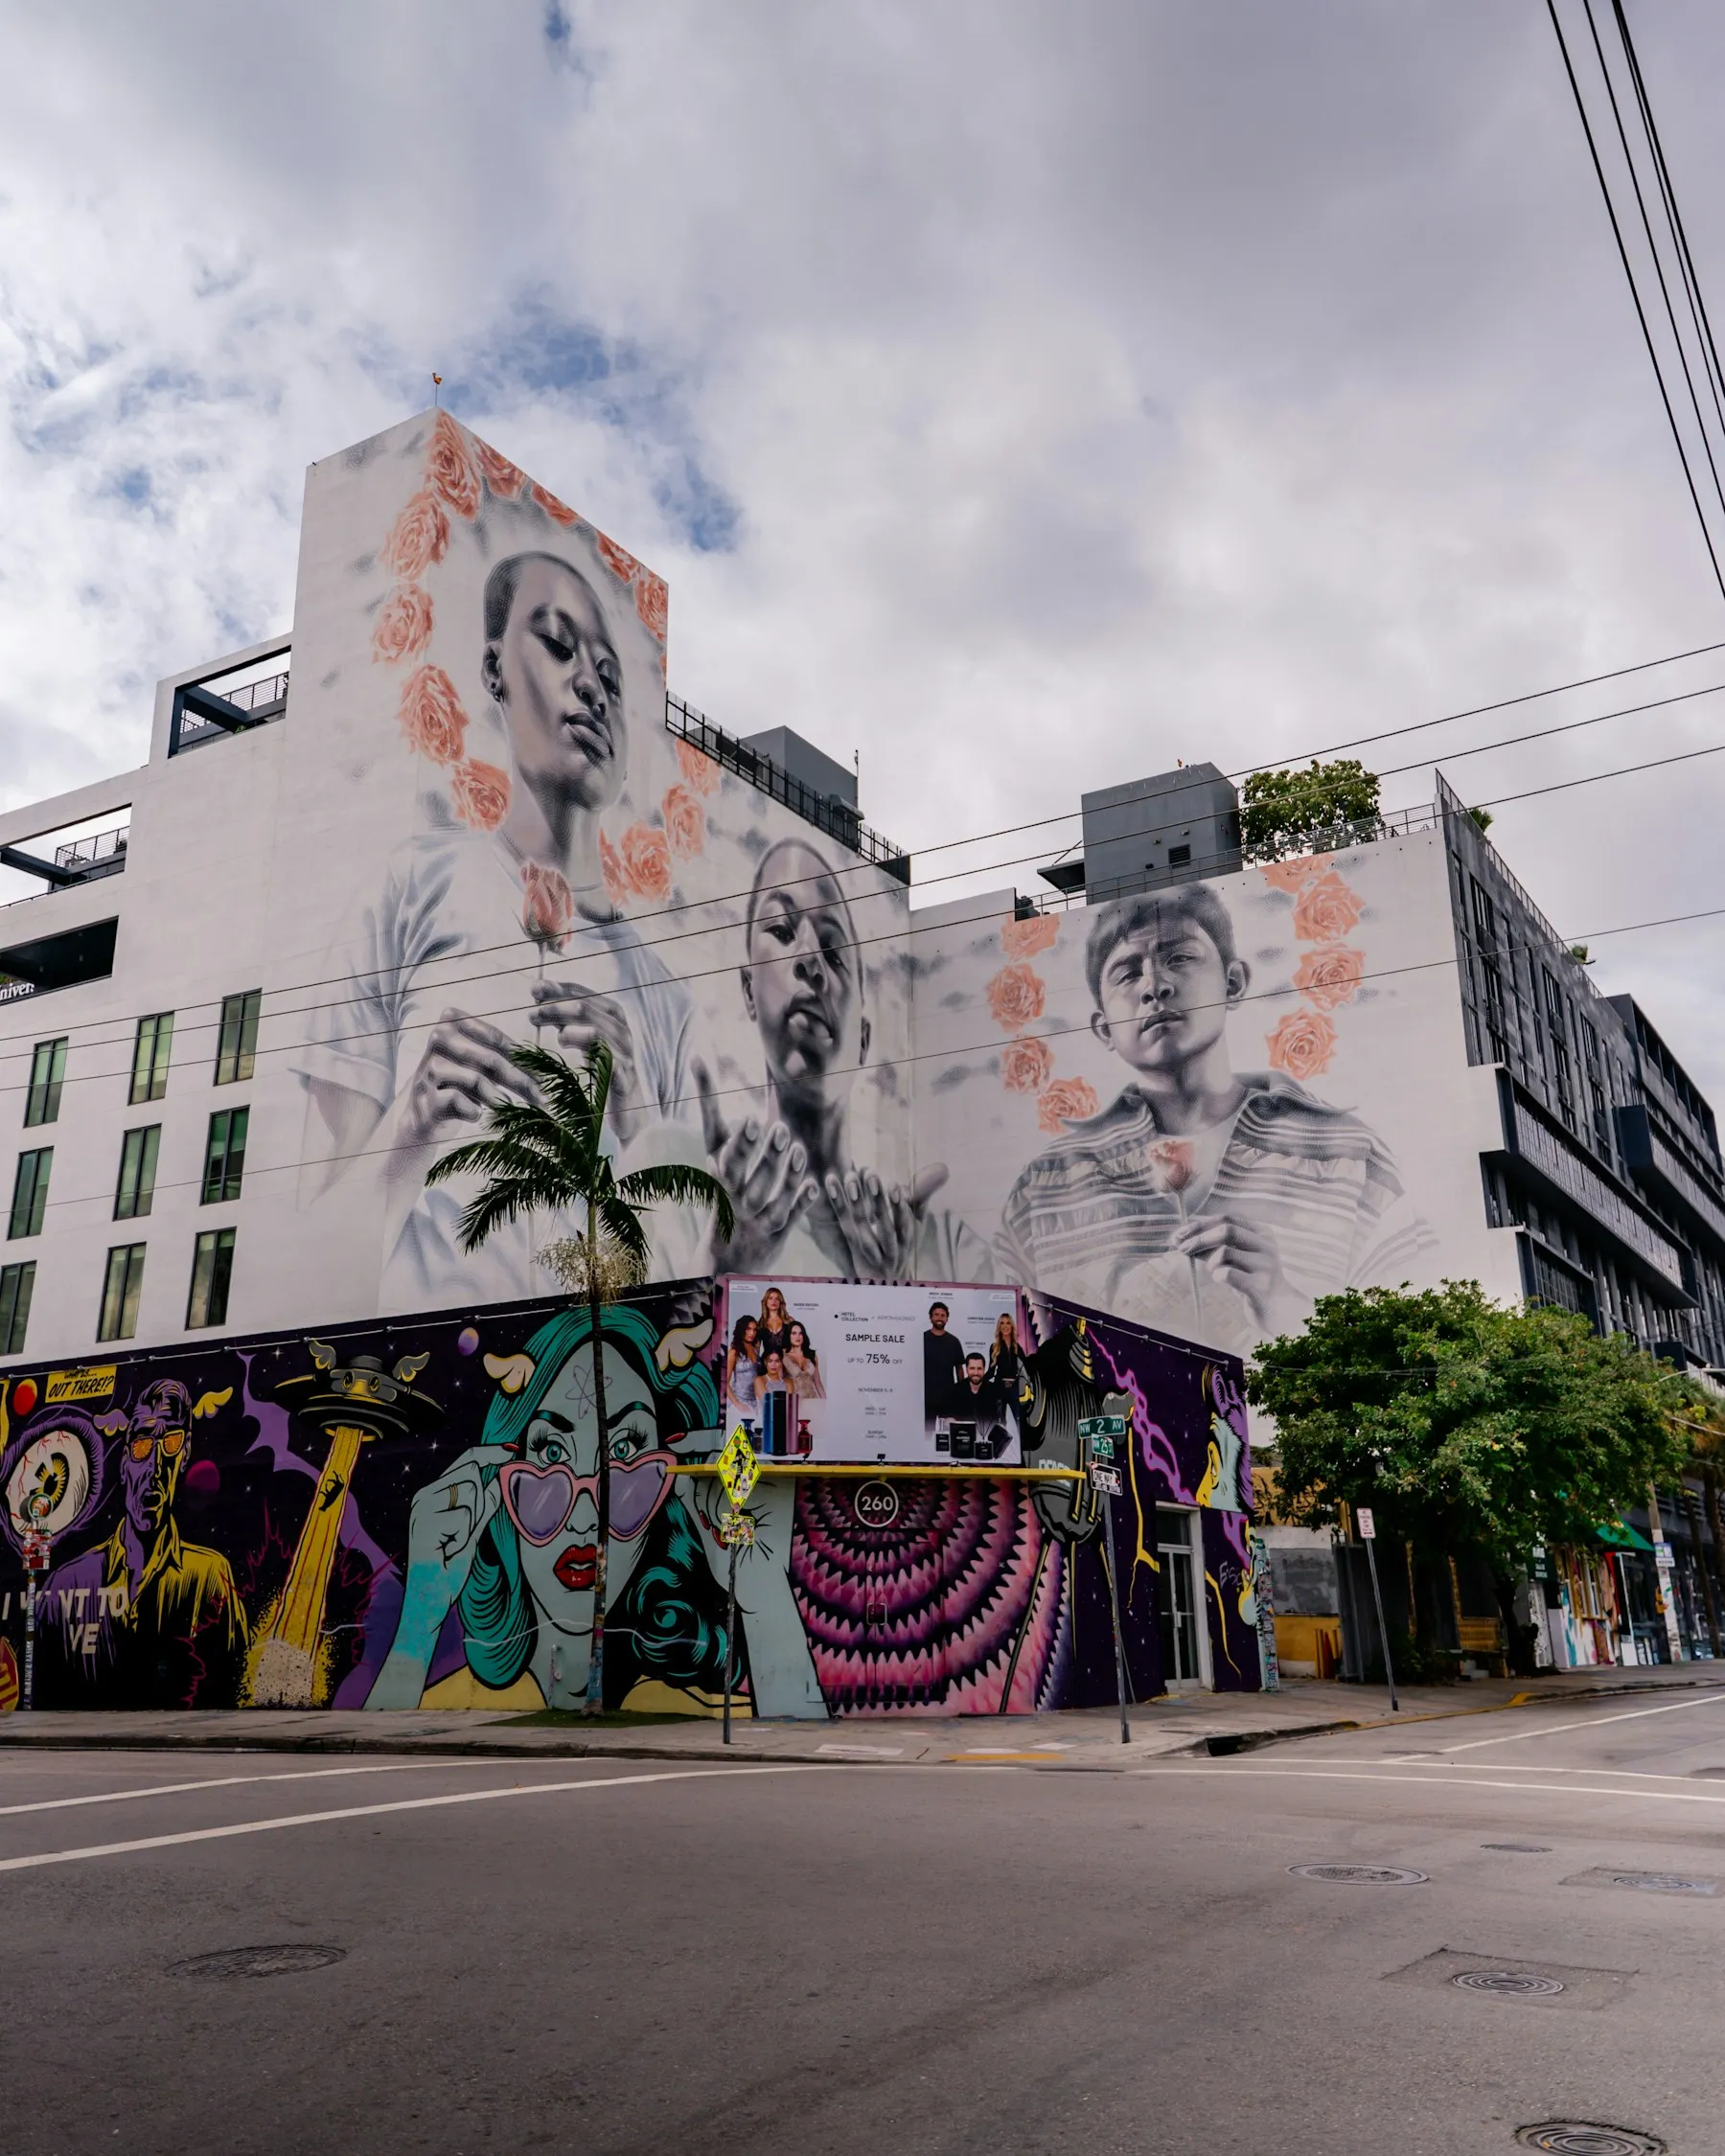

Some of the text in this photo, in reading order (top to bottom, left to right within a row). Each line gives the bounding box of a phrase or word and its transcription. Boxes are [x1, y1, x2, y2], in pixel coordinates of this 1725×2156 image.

[845, 1333, 906, 1343] SAMPLE SALE
[865, 1353, 890, 1365] 75%
[48, 1381, 72, 1398] OUT
[1080, 1419, 1122, 1434] NW 2 AV
[1093, 1470, 1103, 1482] ONE
[862, 1496, 893, 1511] 260
[2, 1592, 12, 1620] I
[97, 1586, 129, 1617] TO
